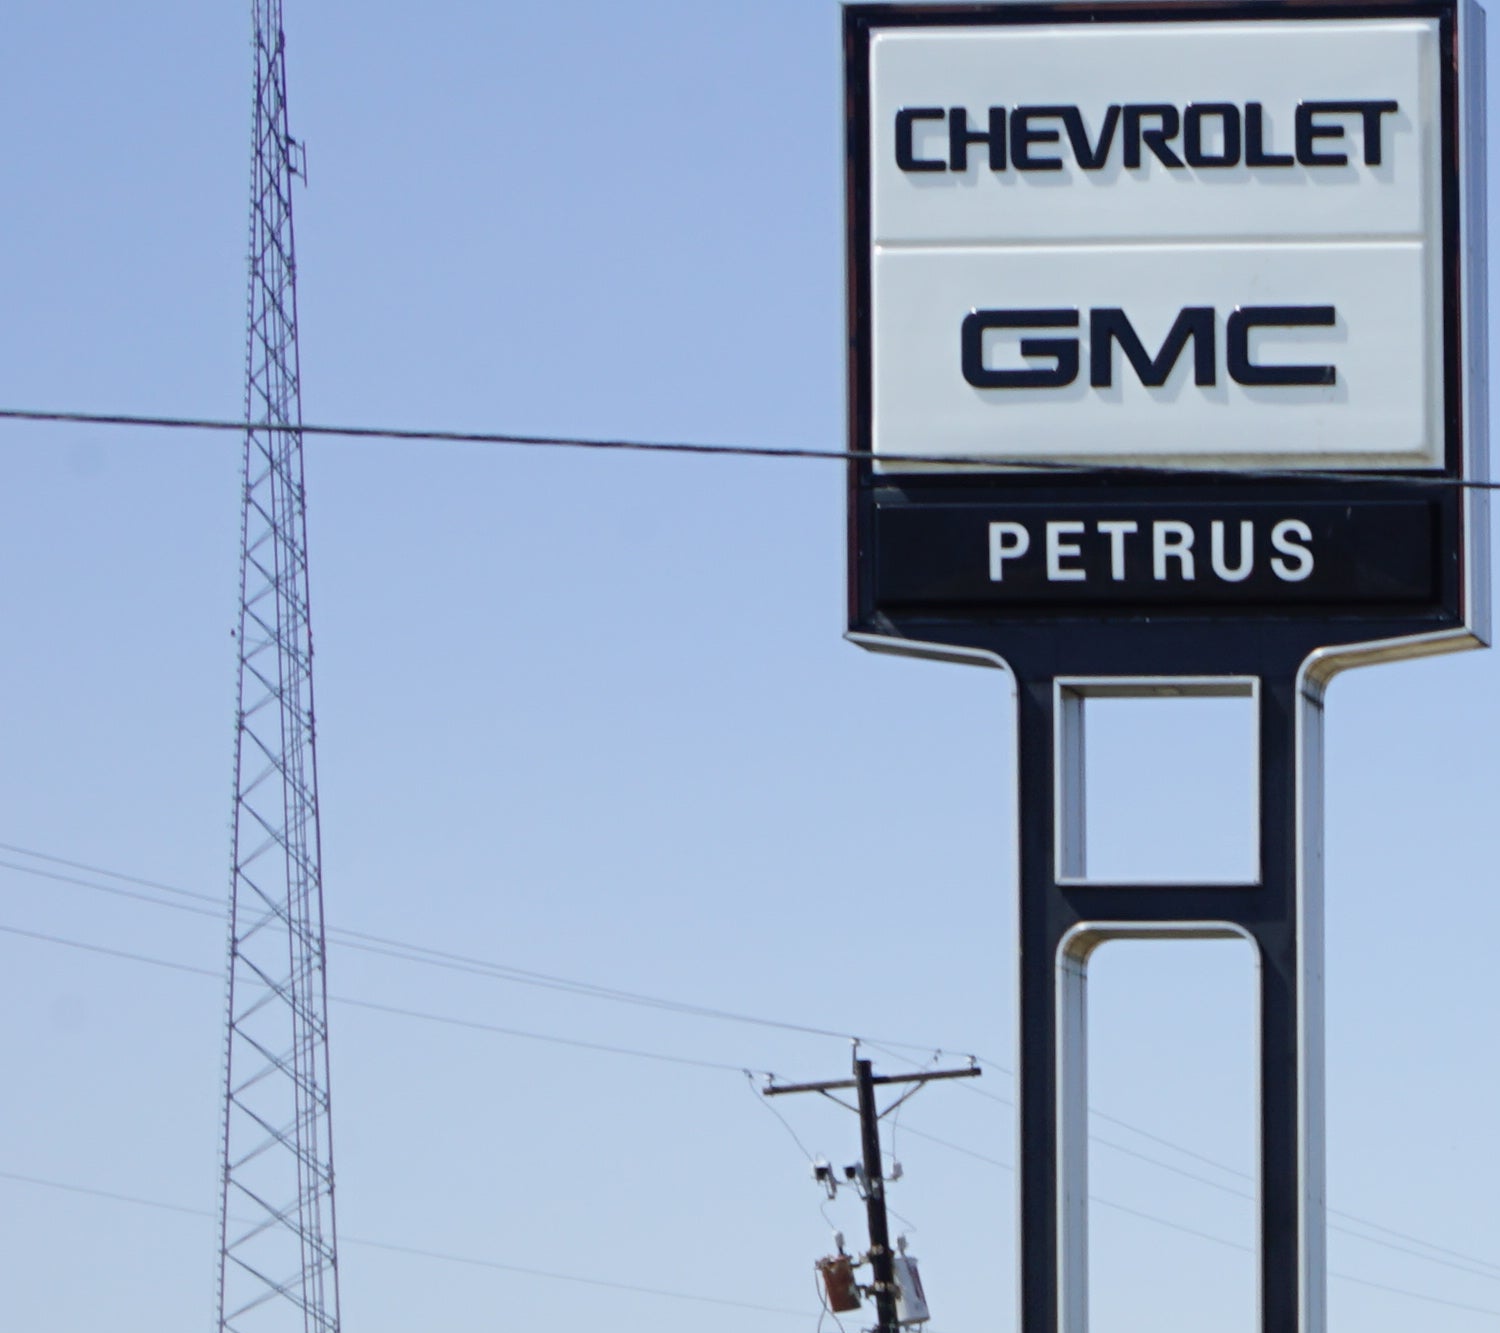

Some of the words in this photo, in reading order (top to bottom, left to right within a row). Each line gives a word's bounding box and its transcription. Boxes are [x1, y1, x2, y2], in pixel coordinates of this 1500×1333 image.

[895, 101, 1398, 171] CHEVROLET
[961, 305, 1336, 388] GMC
[988, 520, 1315, 582] PETRUS
